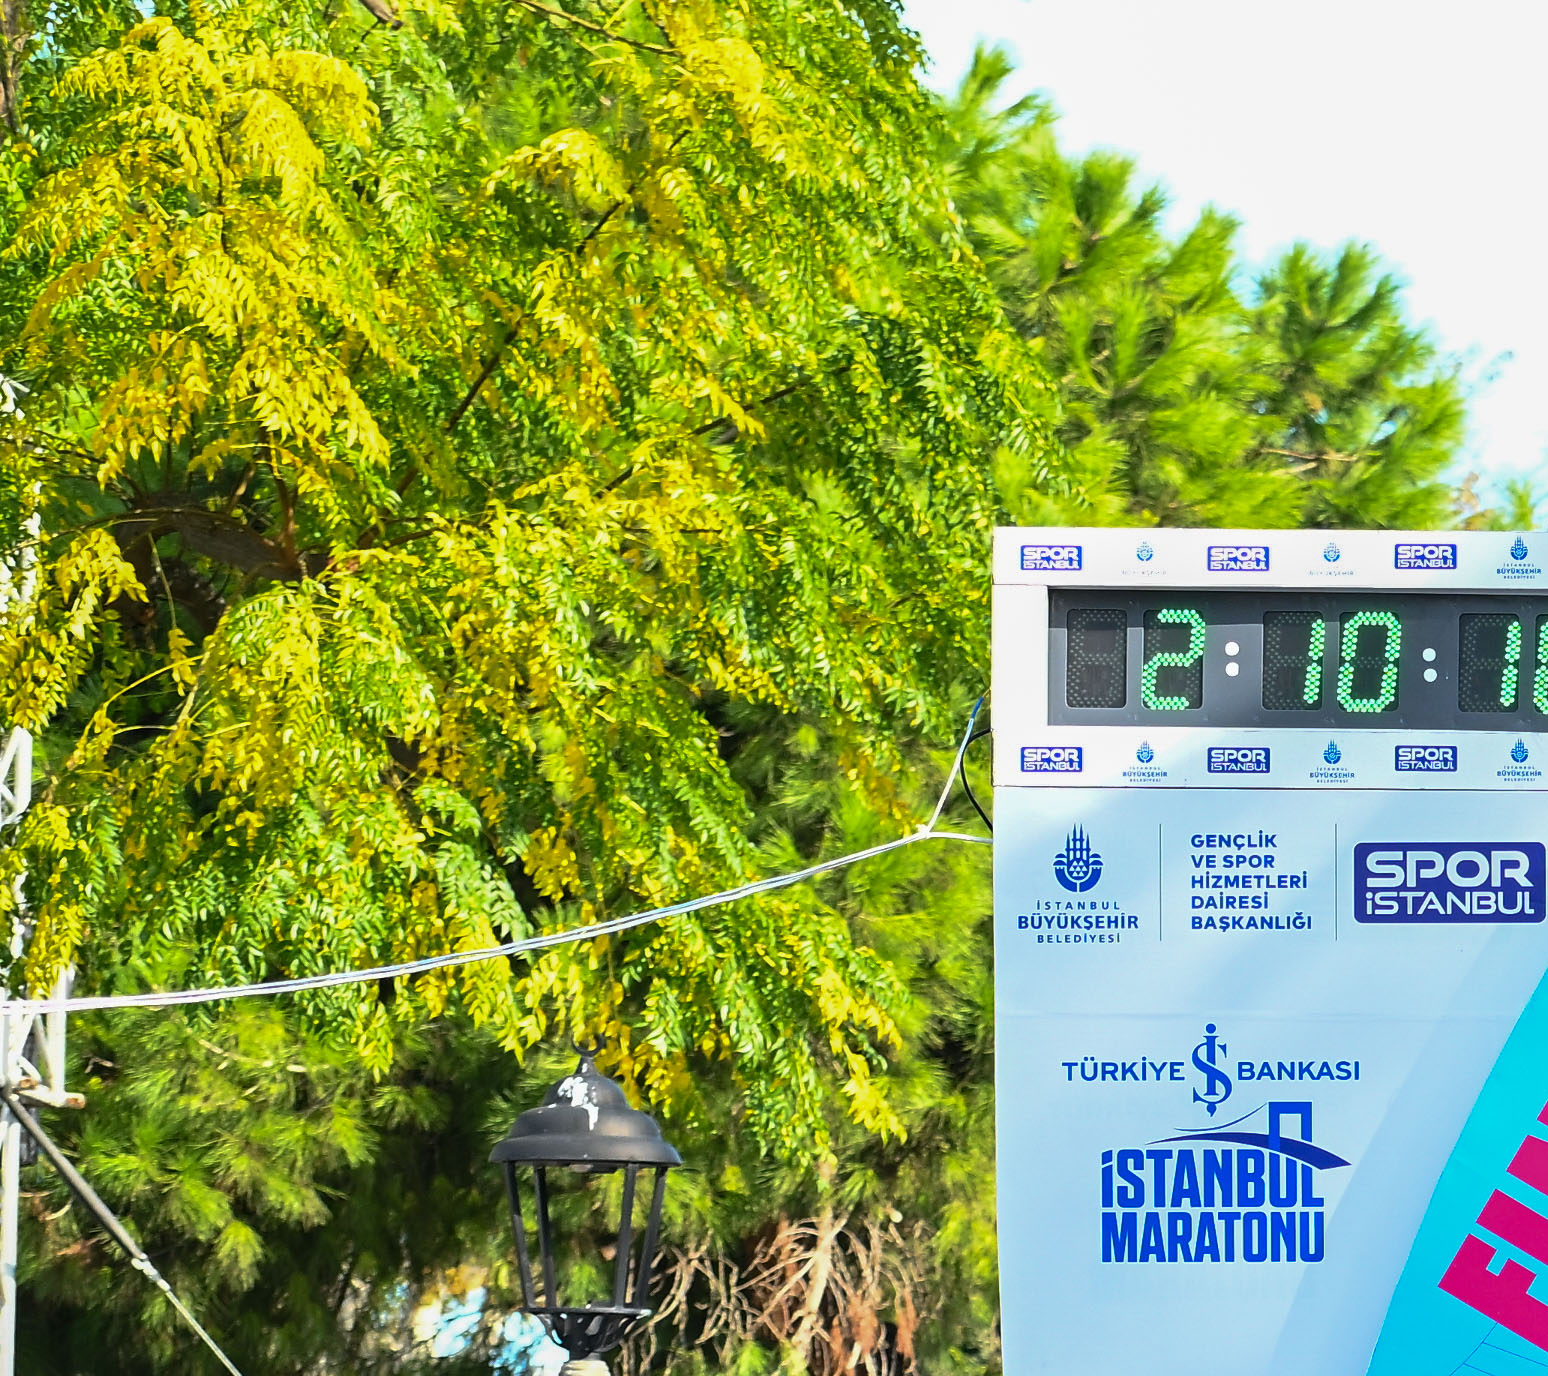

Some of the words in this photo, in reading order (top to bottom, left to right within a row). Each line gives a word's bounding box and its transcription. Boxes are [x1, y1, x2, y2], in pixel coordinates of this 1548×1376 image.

[1191, 830, 1276, 851] GENÇLİK
[1191, 854, 1218, 868] VE
[1223, 854, 1274, 868] SPOR
[1367, 850, 1535, 888] SPOR
[1191, 871, 1307, 889] HİZMETLERİ
[1037, 899, 1120, 910] İSTANBUL
[1191, 892, 1269, 909] DAİRESİ
[1018, 912, 1138, 932] BÜYÜKŞEHİR
[1191, 911, 1312, 932] BAŞKANLIĞI
[1037, 933, 1120, 943] BELEDİYESİ
[1062, 1056, 1185, 1081] TÜRKİYE
[1238, 1061, 1359, 1081] BANKASI
[1102, 1149, 1324, 1208] İSTANBUL
[1102, 1212, 1324, 1262] MARATONU
